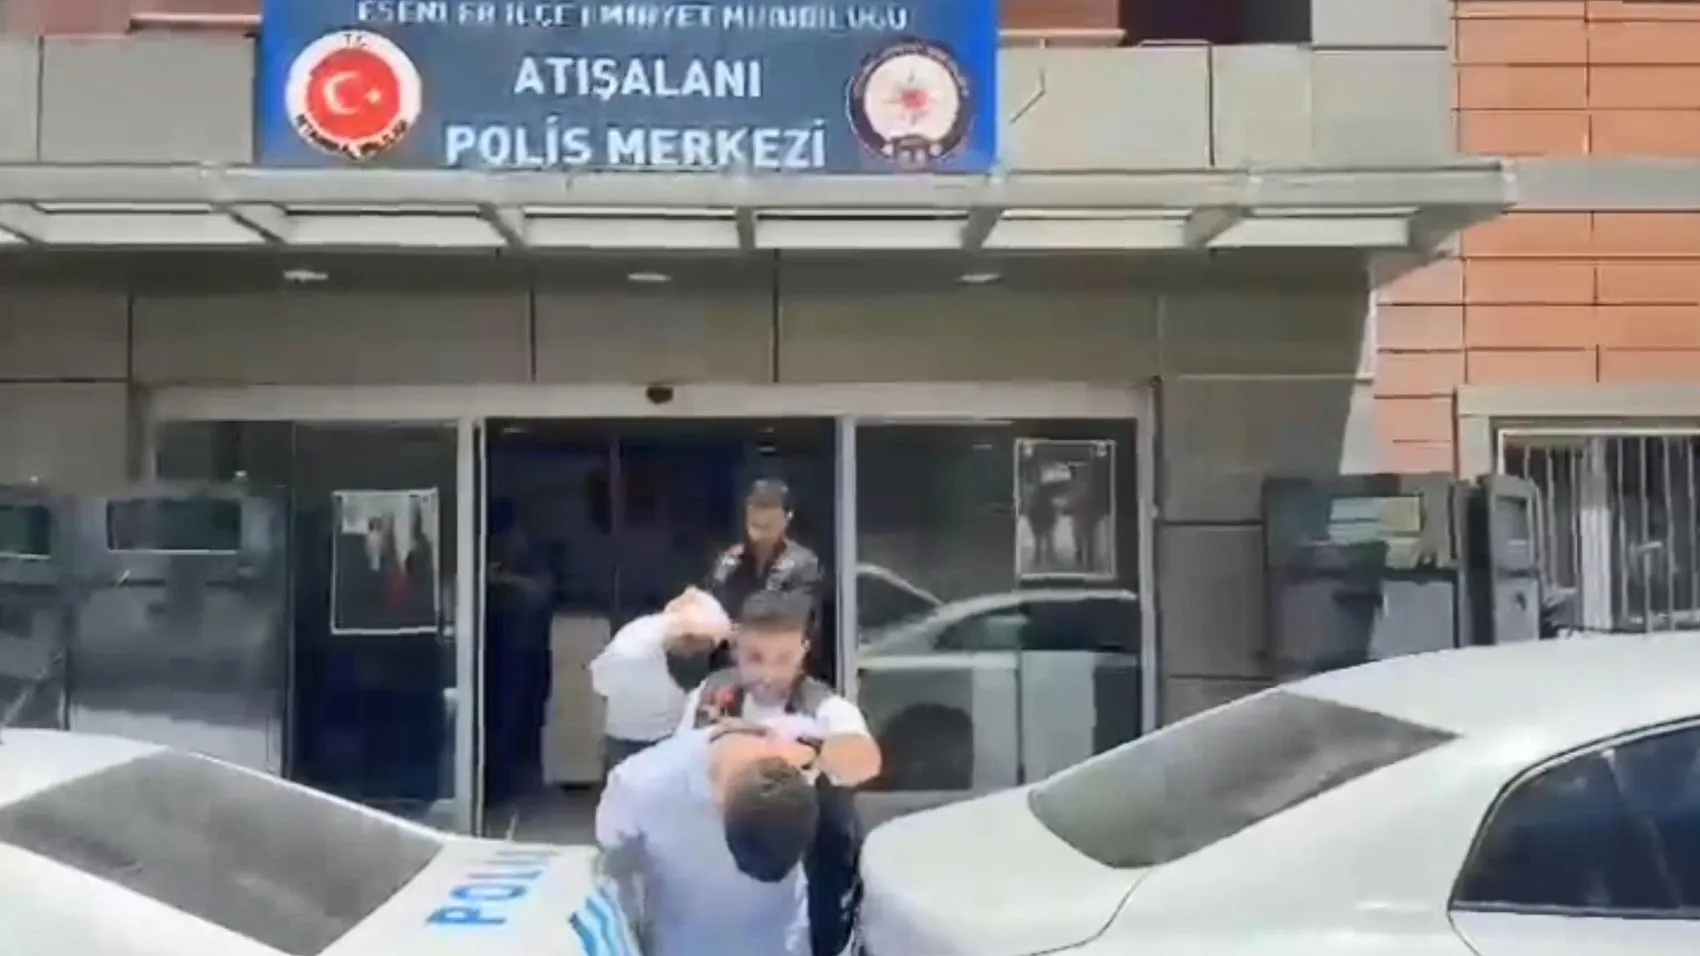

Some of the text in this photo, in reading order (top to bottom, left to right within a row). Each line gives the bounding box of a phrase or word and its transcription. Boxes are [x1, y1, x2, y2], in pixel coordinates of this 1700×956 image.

[514, 57, 762, 100] ATIŞALANI
[446, 115, 592, 166] POLİS
[606, 119, 826, 168] MERKEZİ
